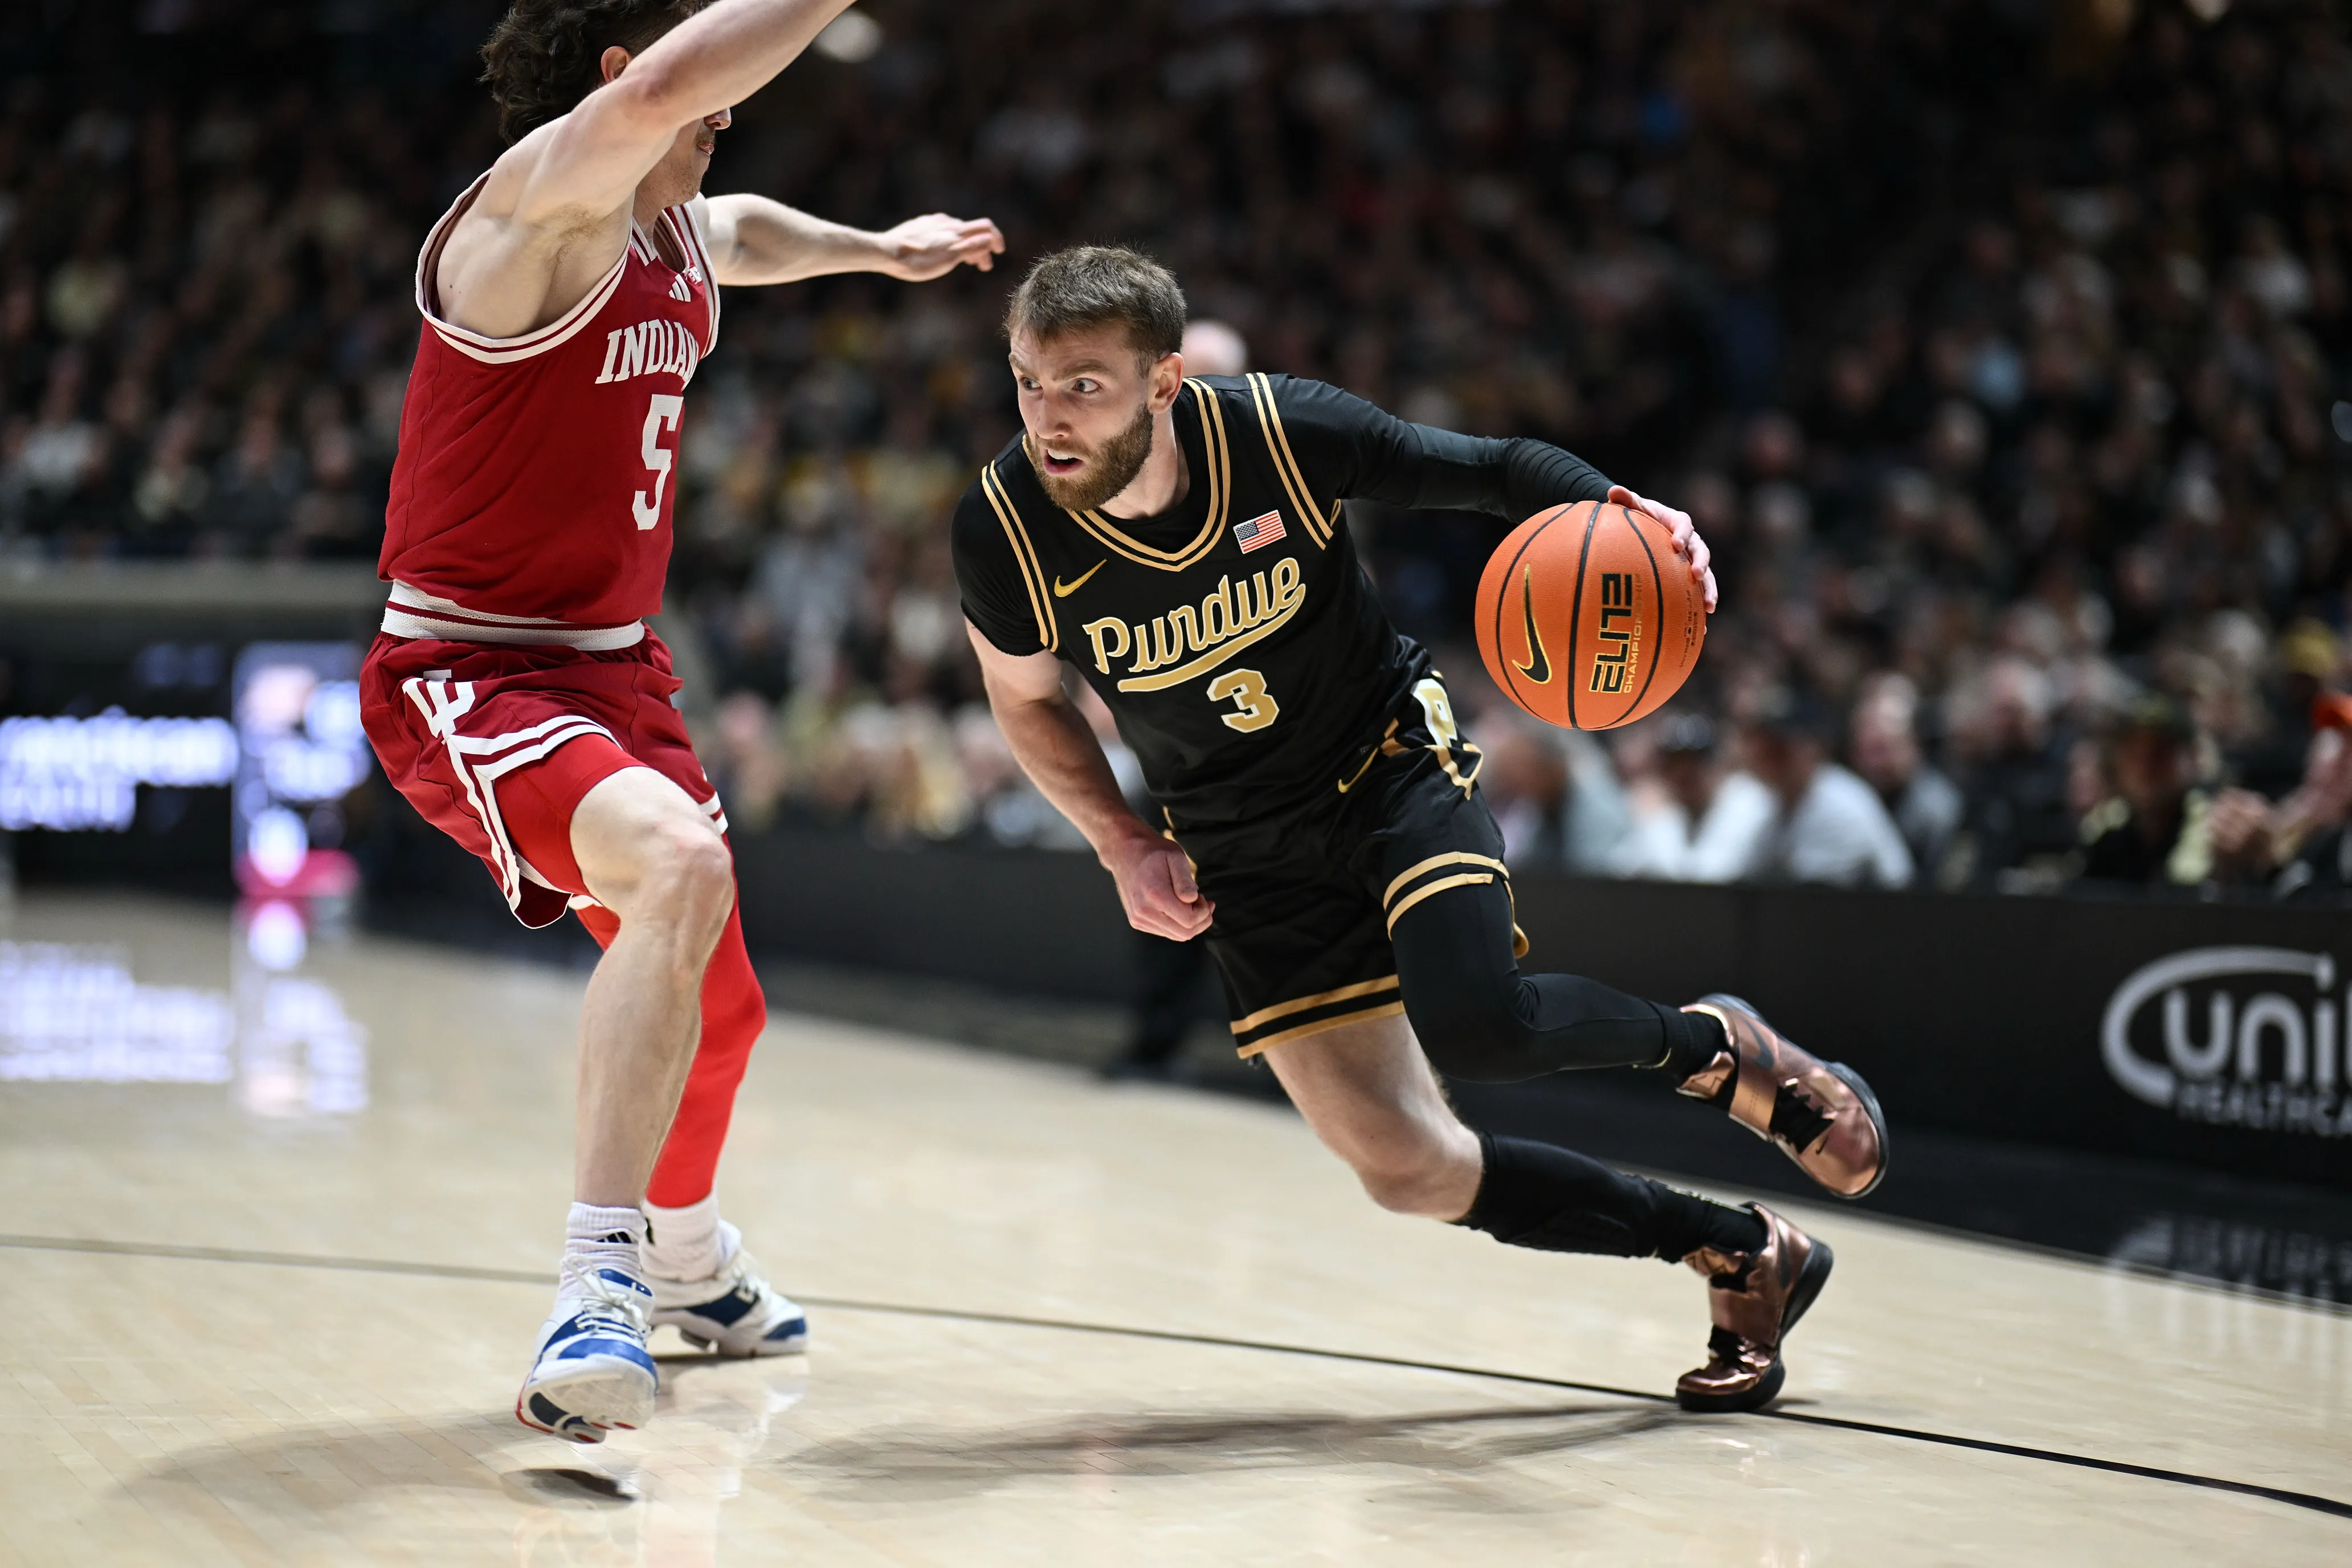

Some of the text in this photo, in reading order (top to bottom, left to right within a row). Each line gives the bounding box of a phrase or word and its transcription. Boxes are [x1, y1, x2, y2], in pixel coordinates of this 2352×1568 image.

[595, 319, 699, 383] INDIAN
[631, 394, 684, 530] 5
[1083, 557, 1306, 674] Purdue
[1589, 573, 1633, 694] ELITE
[1207, 668, 1280, 733] 3
[2163, 953, 2352, 1089] uni
